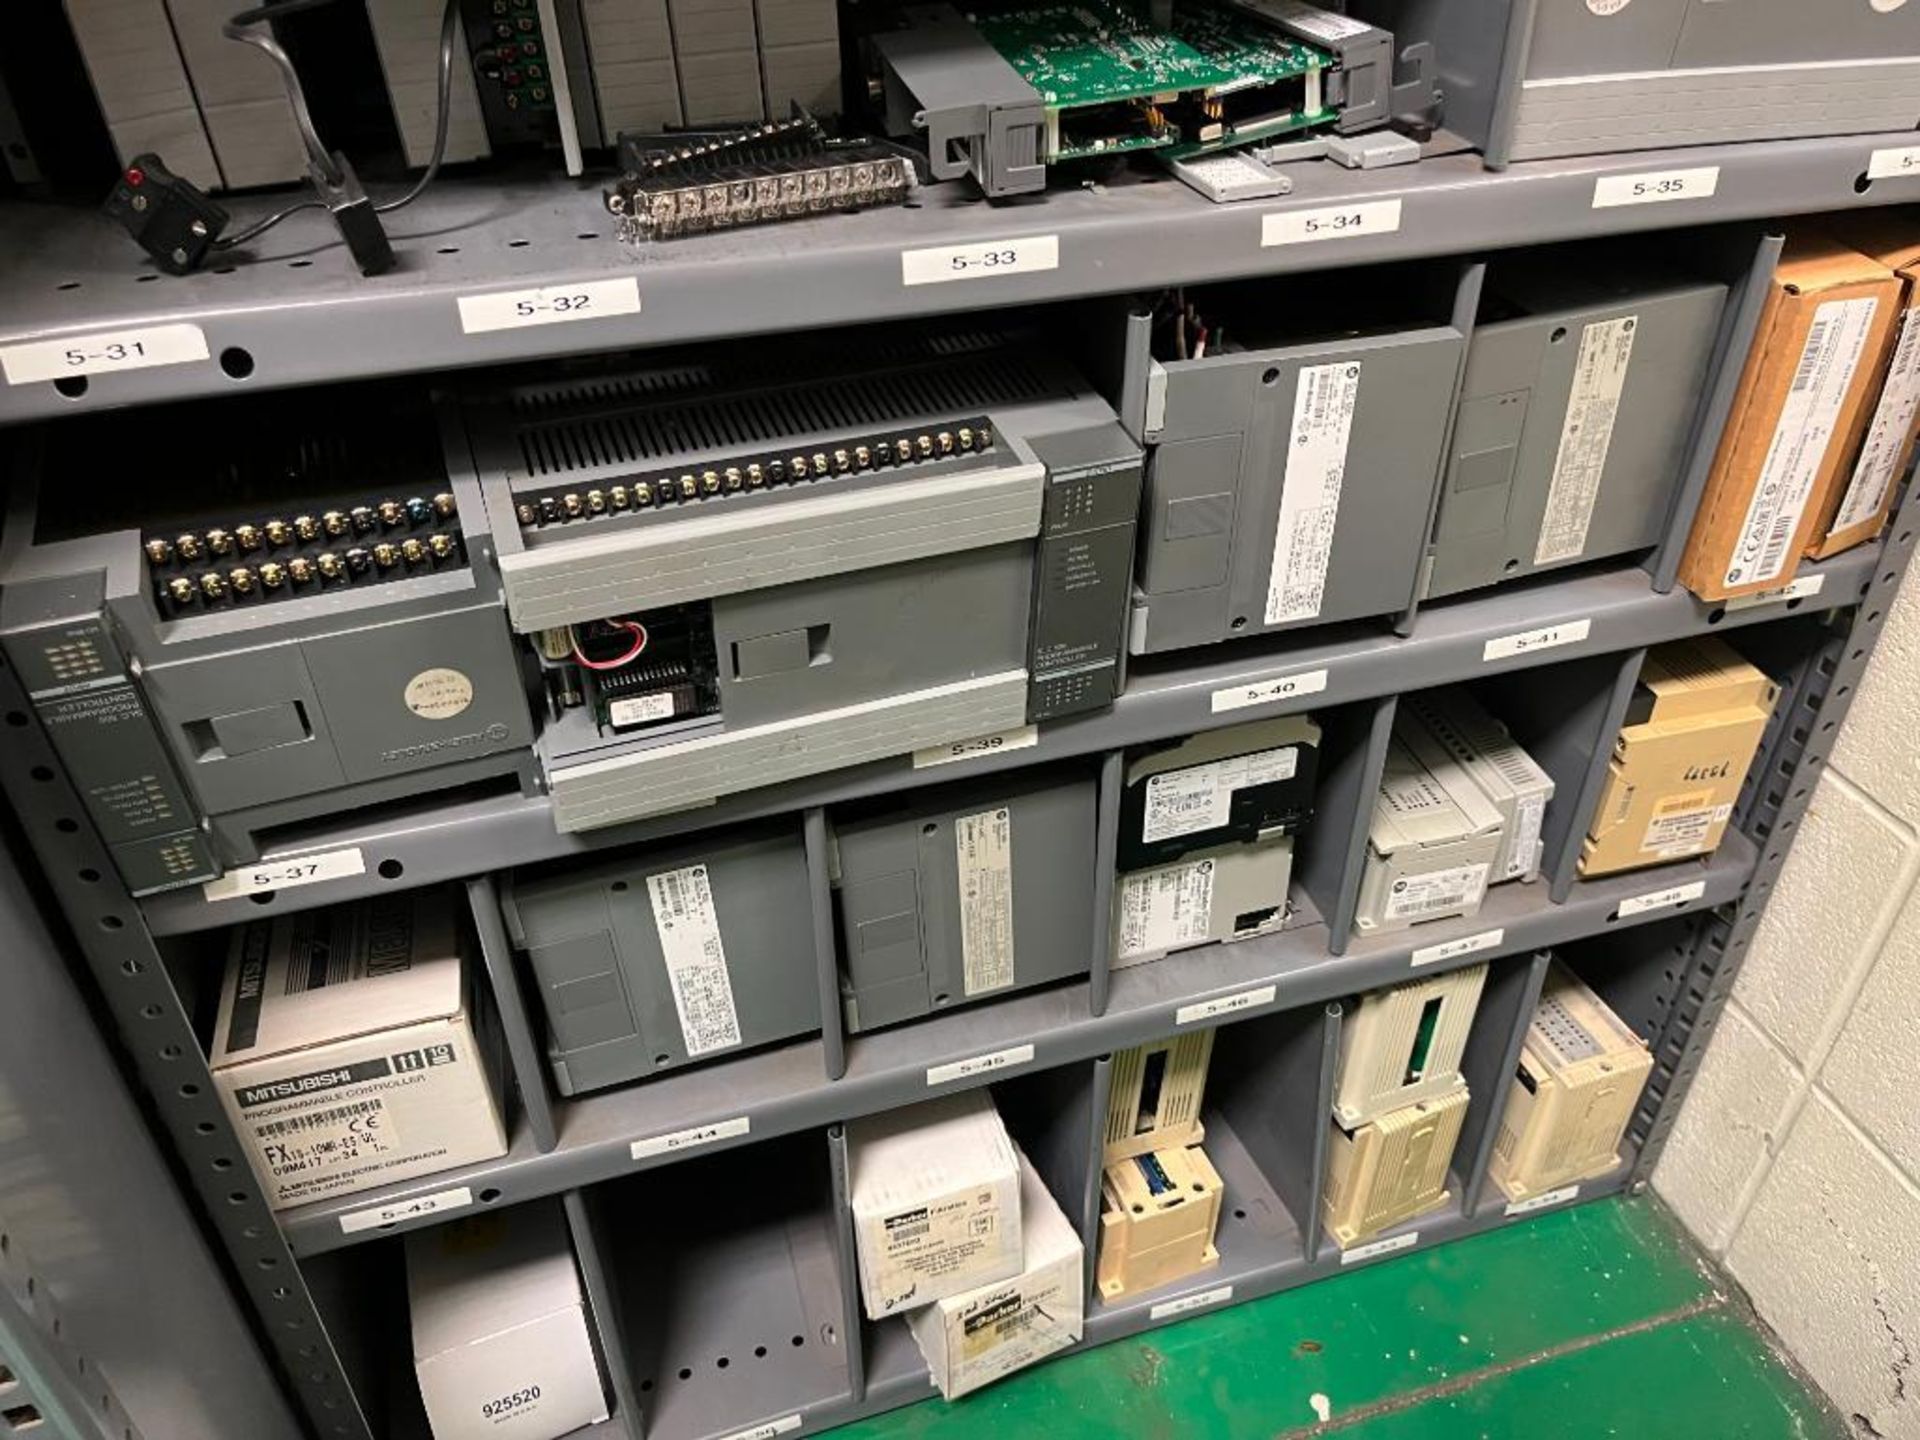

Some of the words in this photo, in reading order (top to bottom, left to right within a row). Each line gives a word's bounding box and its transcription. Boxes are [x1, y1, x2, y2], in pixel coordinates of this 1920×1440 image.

[1633, 179, 1683, 196] 5-35
[1305, 214, 1361, 232] 5-34
[952, 250, 1016, 270] 5-33
[516, 295, 590, 316] 5-32
[66, 342, 144, 365] 5-31
[1516, 632, 1557, 649] 5-41
[1247, 683, 1295, 700] 5-40
[952, 737, 1003, 756] 5-39
[254, 864, 317, 885] 5-37
[246, 1071, 351, 1102] MITSUBISHI
[243, 1093, 344, 1120] PROGRAMMABLE
[346, 1074, 427, 1098] CONTROLLER
[381, 1201, 436, 1219] 5-43
[482, 1385, 541, 1418] 925520
